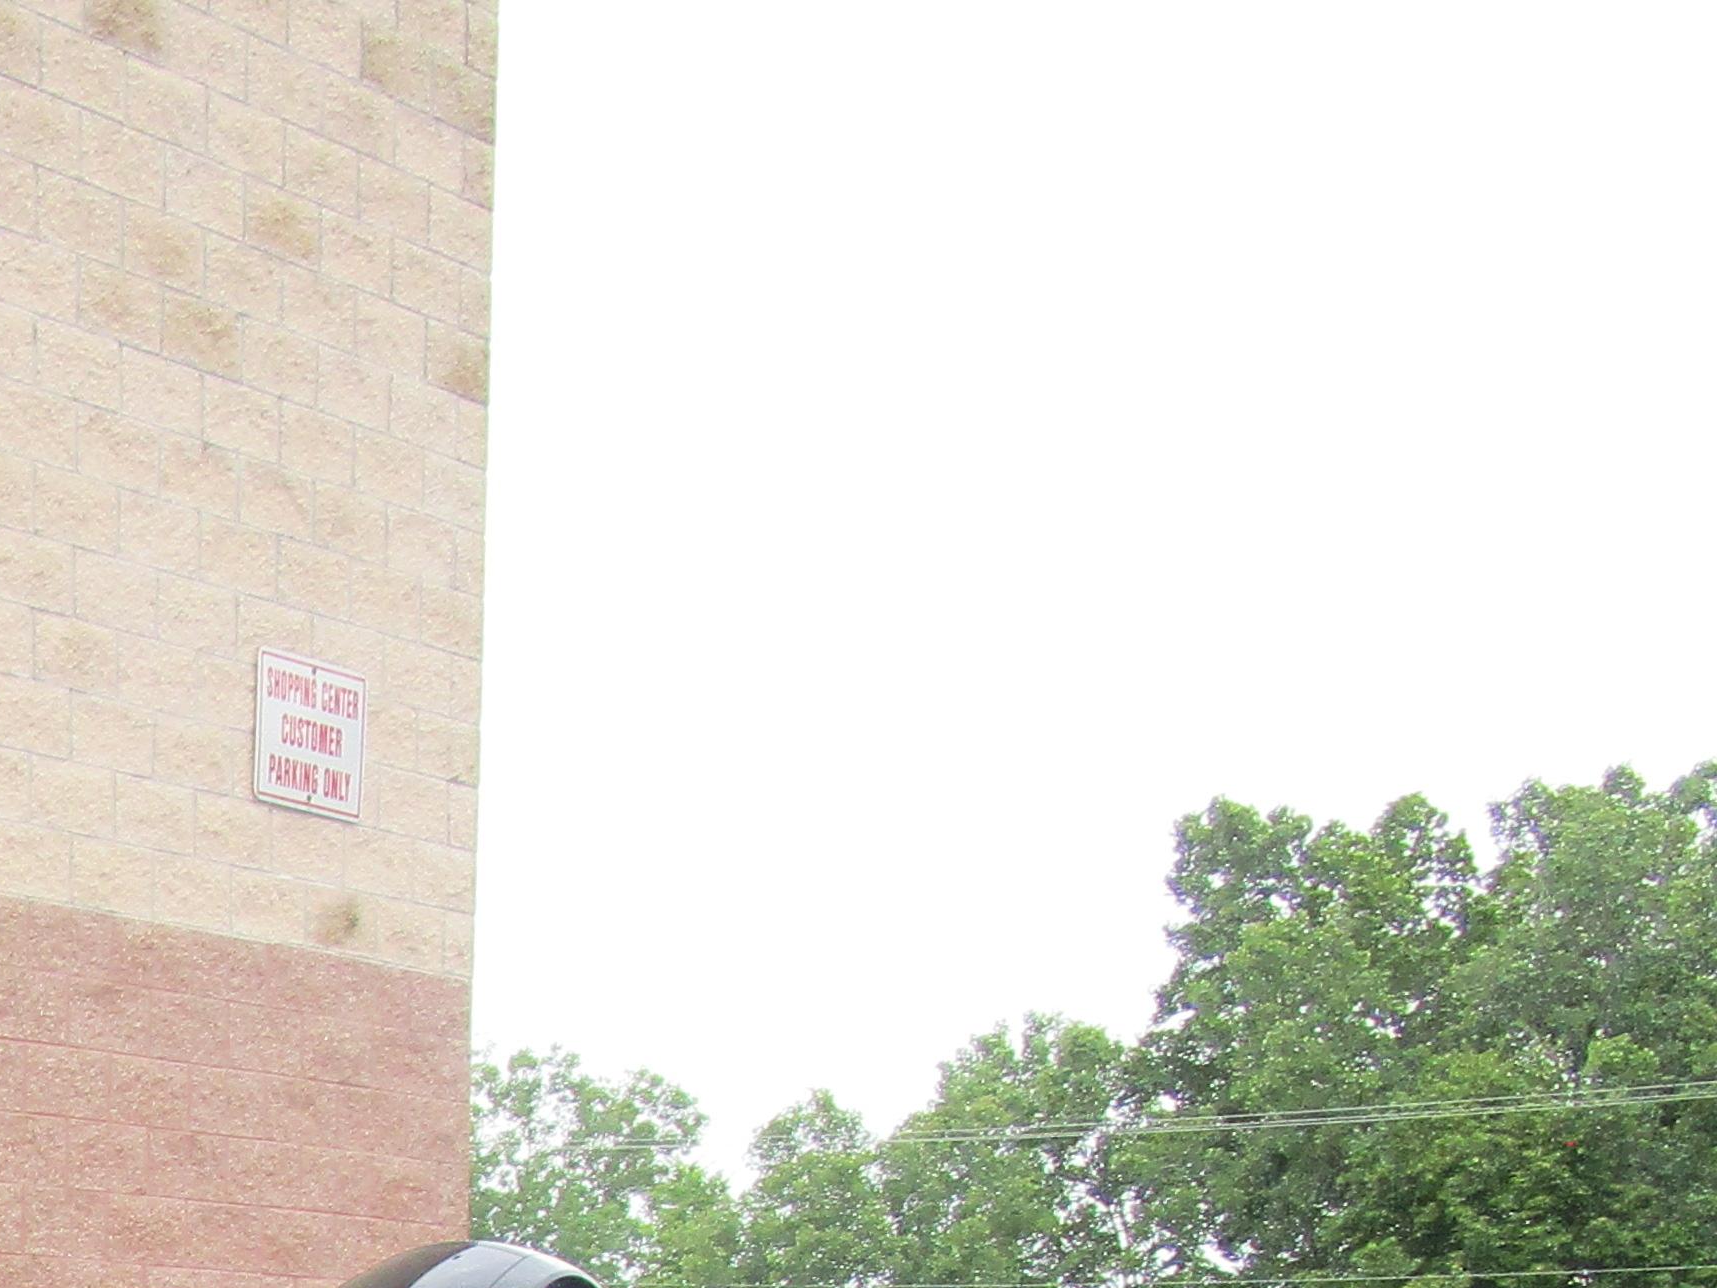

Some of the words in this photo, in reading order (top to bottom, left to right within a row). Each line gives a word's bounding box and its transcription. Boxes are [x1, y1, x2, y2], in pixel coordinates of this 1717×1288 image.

[267, 667, 317, 709] SHOPPING
[321, 681, 359, 721] CENTER
[281, 713, 343, 758] CUSTOMER
[268, 753, 318, 794] PARKING
[323, 767, 352, 802] ONLY
